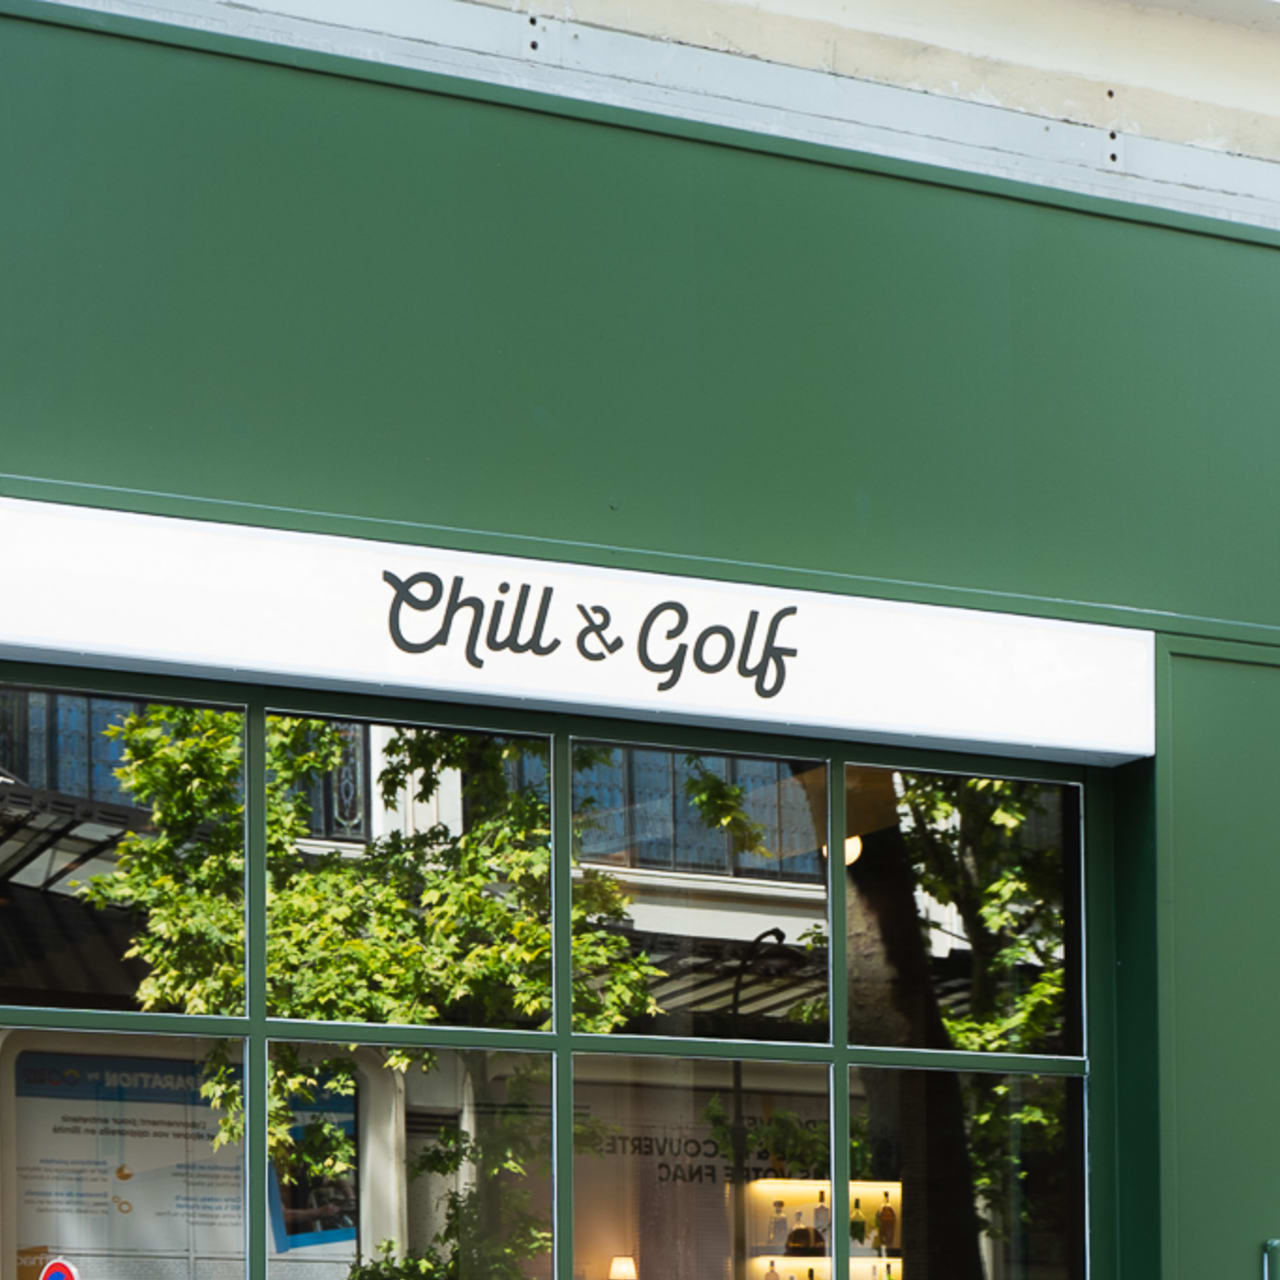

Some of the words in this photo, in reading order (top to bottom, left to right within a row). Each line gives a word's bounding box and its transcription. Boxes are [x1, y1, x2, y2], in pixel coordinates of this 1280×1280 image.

[382, 570, 561, 670] Chill
[576, 602, 624, 661] &
[636, 600, 798, 699] Golf
